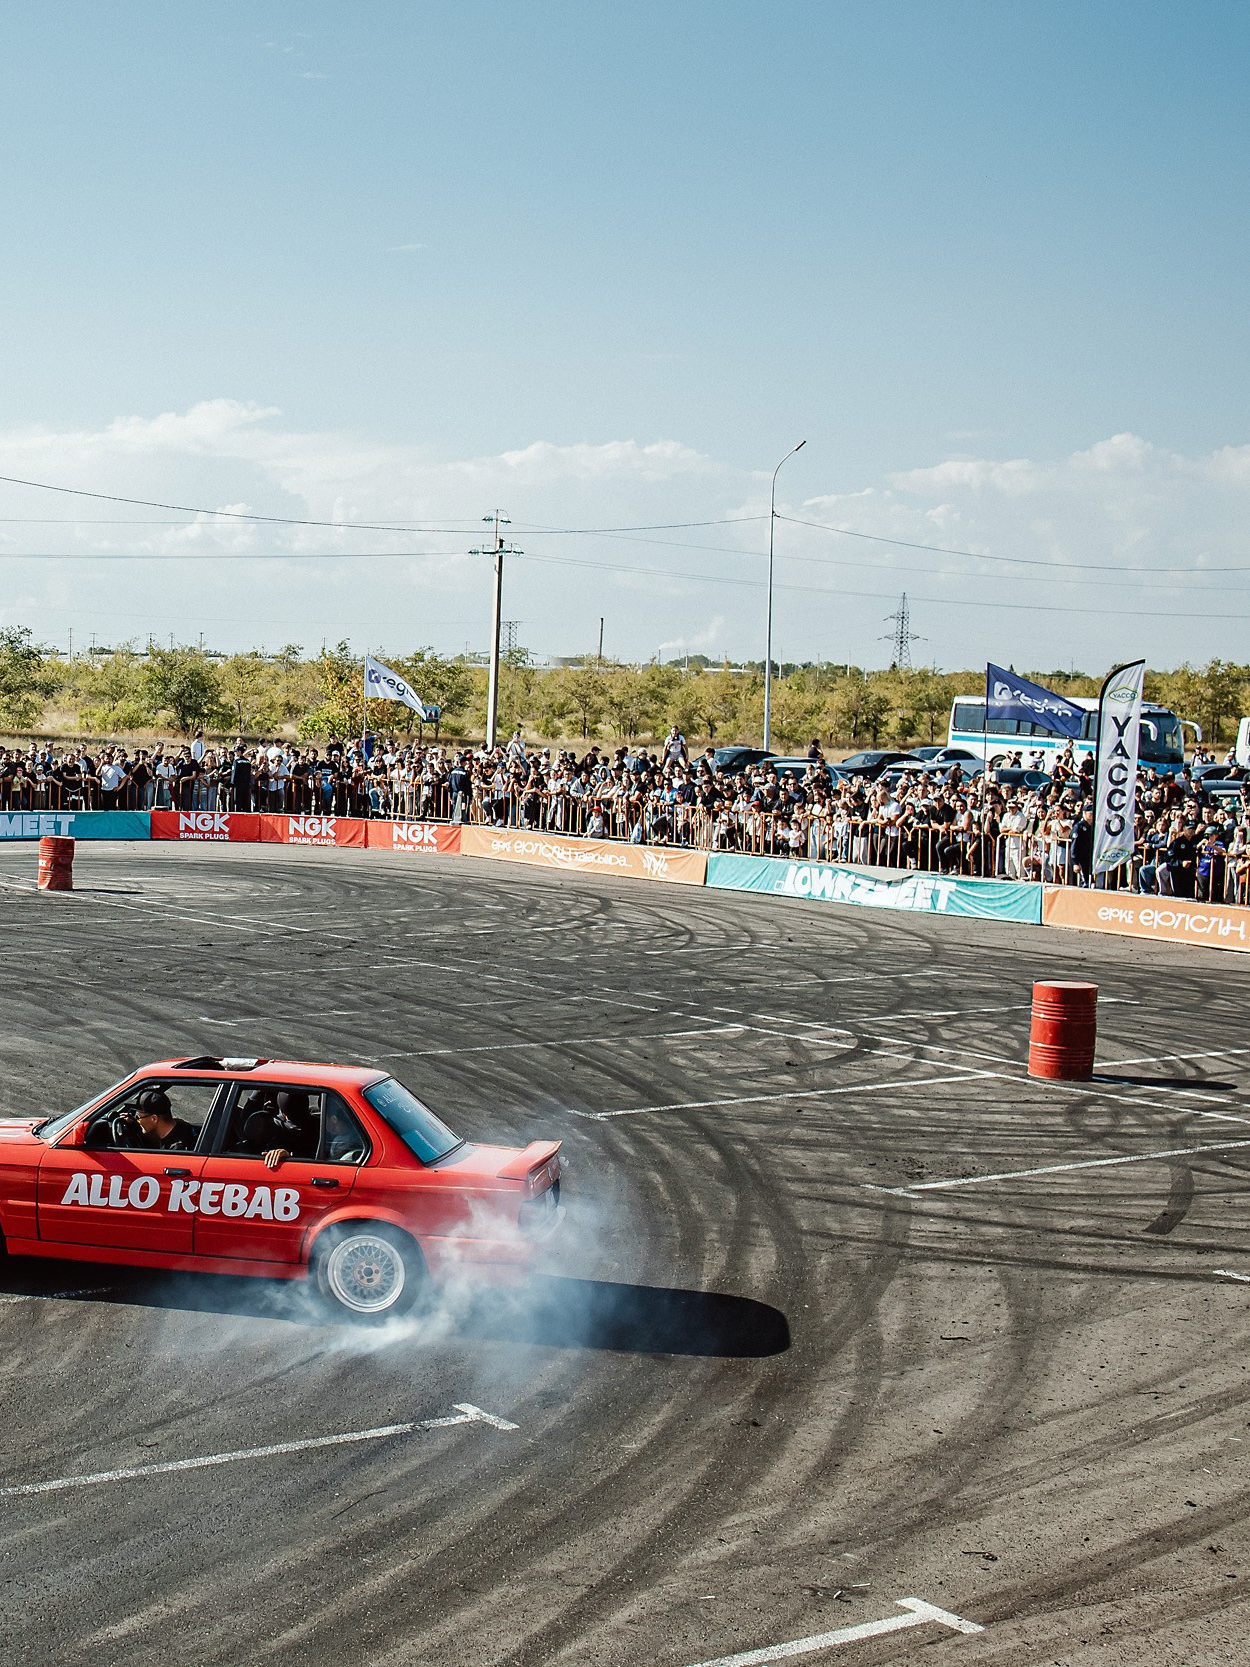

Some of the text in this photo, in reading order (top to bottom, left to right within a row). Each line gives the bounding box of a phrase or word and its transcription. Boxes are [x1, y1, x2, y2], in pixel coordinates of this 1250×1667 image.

[1105, 716, 1132, 837] YACCO
[179, 813, 230, 832] NGK
[289, 817, 337, 838] NGK
[289, 836, 311, 844] SPARK
[393, 823, 438, 844] NGK
[393, 843, 437, 853] SPARK PLUGS
[61, 1173, 300, 1222] ALLO KEBAB
